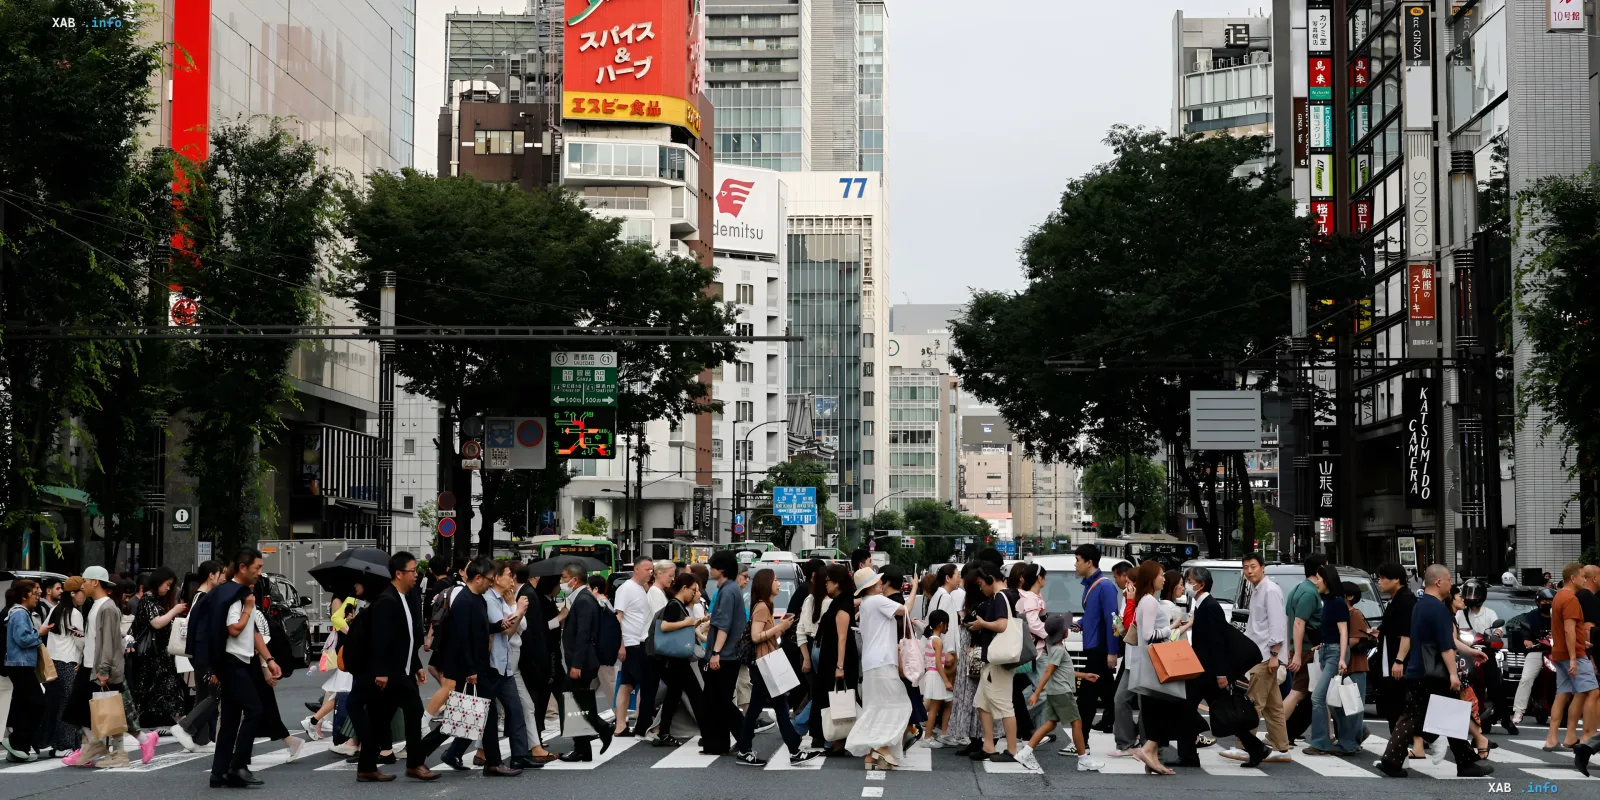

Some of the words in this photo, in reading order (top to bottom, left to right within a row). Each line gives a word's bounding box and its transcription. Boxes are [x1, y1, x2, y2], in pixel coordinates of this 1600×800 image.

[1319, 14, 1328, 46] カツミ堂
[1553, 11, 1580, 21] 10号館
[579, 21, 656, 53] スパイス
[1413, 30, 1422, 59] GINZA
[595, 56, 653, 85] ハーブ
[614, 47, 631, 64] &
[571, 97, 662, 117] エスビー食品
[839, 178, 868, 199] 77
[1413, 171, 1428, 247] SONOKO
[713, 219, 764, 240] demitsu
[1411, 274, 1421, 313] ステーキ
[1421, 268, 1432, 298] 銀座の
[1408, 419, 1419, 494] CAMERA
[1420, 387, 1430, 500] KATSUMIDO
[1319, 460, 1334, 508] 山形屋
